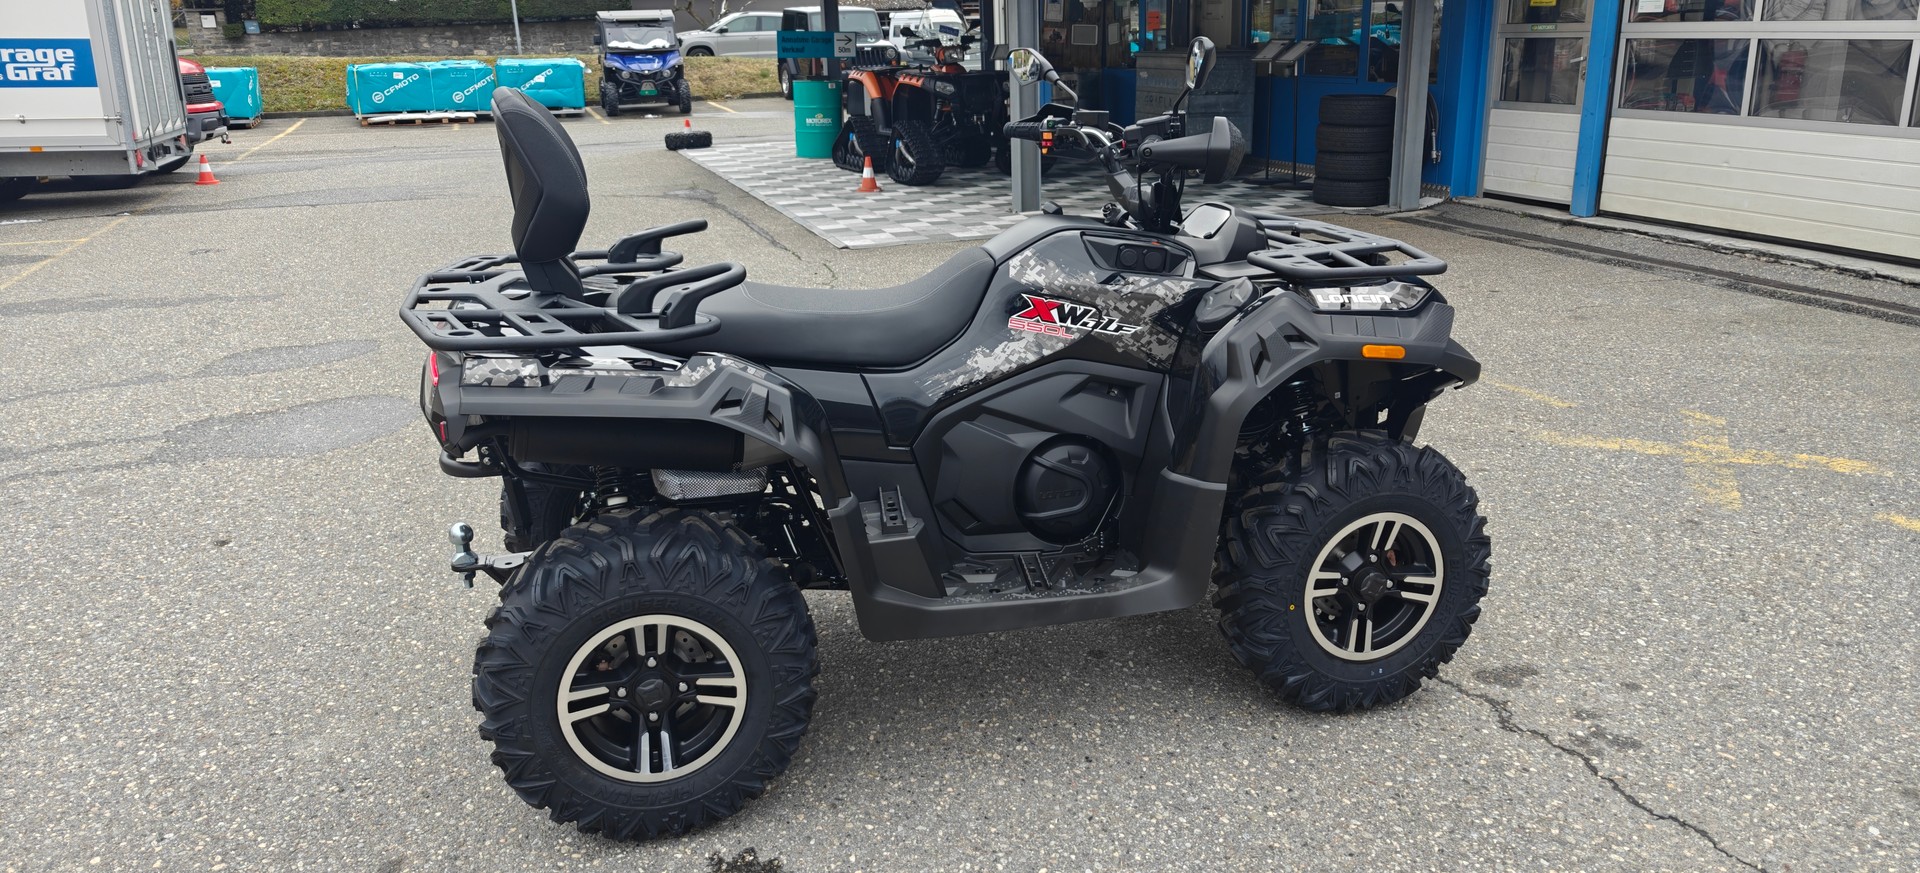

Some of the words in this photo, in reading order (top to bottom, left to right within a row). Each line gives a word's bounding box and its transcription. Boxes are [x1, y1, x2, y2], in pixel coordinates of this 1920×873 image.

[5, 63, 76, 81] Graf
[383, 73, 420, 96] CFMOTO
[1008, 317, 1074, 339] 550L
